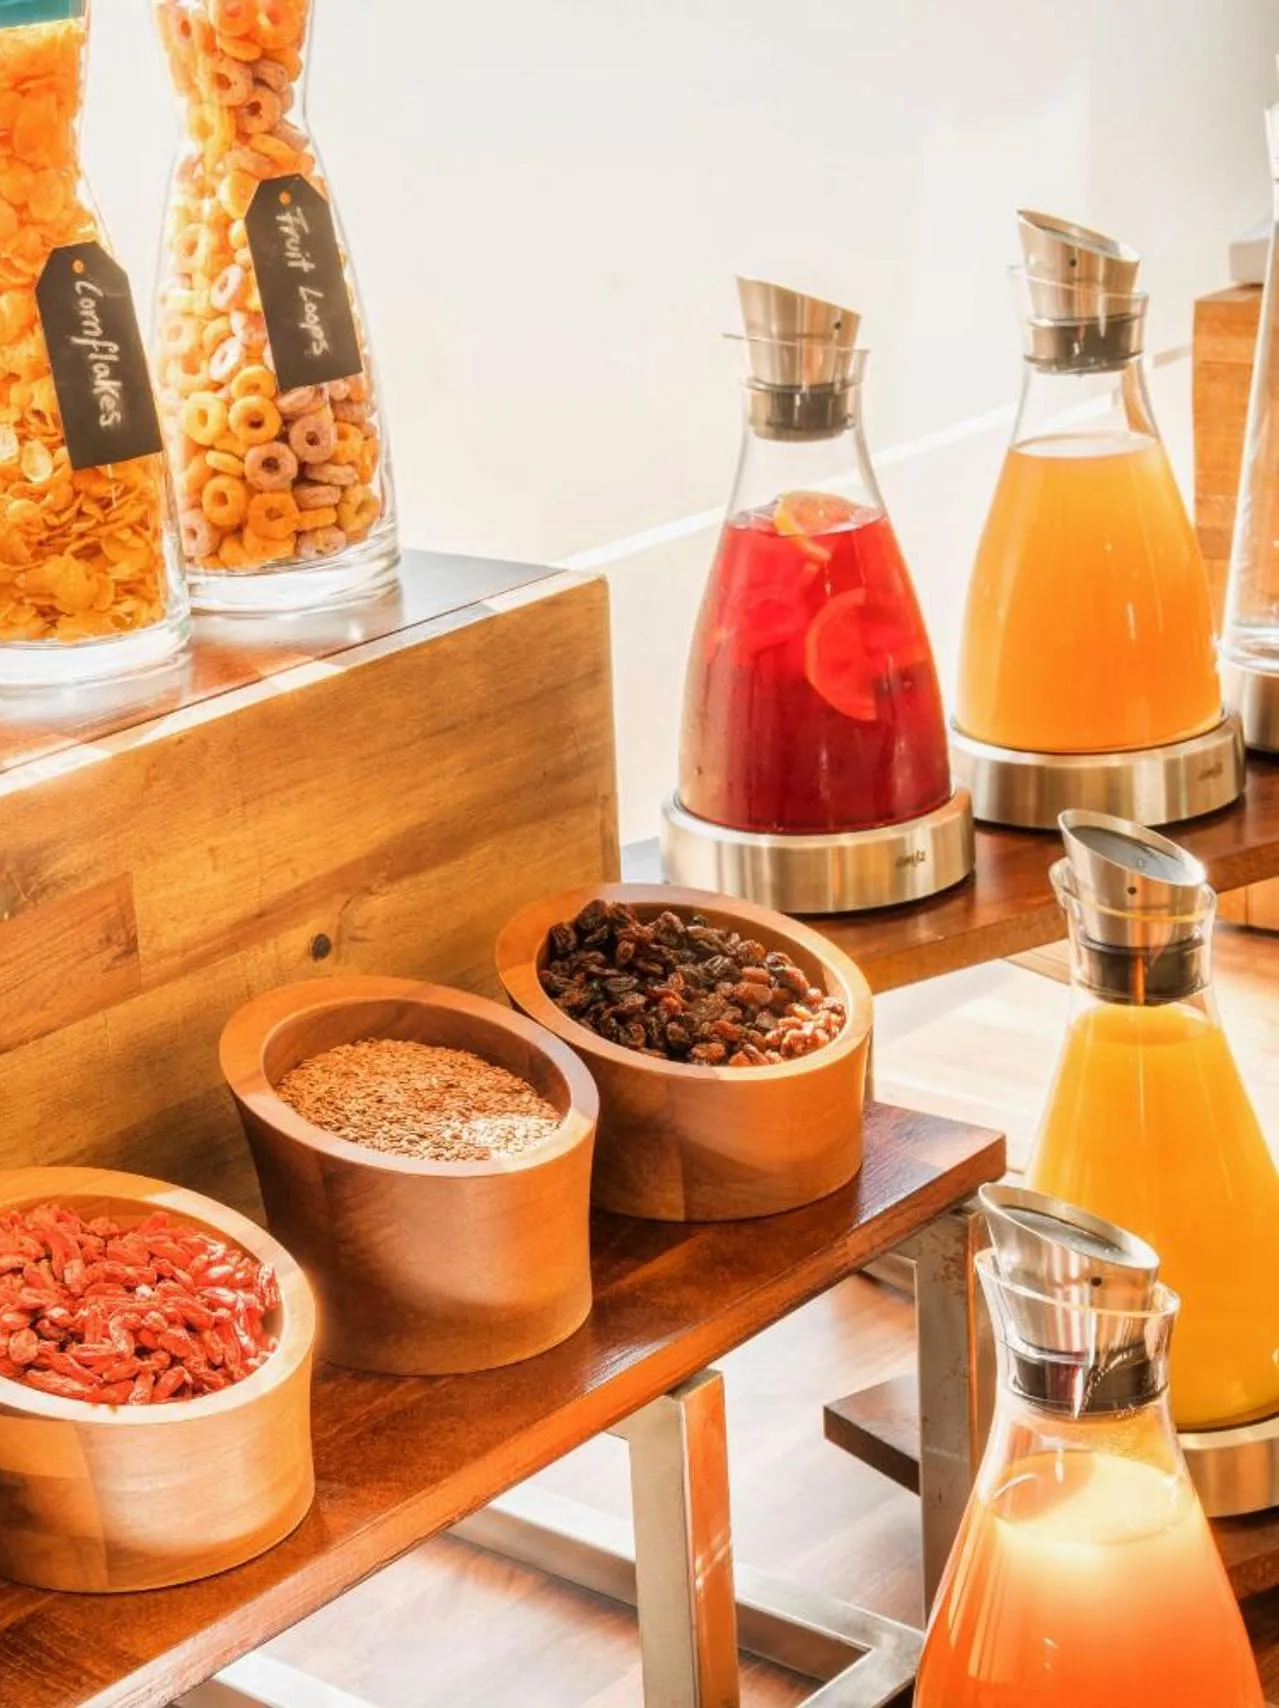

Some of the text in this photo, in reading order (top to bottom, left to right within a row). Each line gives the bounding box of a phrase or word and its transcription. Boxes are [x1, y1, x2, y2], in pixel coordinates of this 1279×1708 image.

[71, 280, 122, 427] Cornflakes
[276, 206, 330, 356] Fruit Loops
